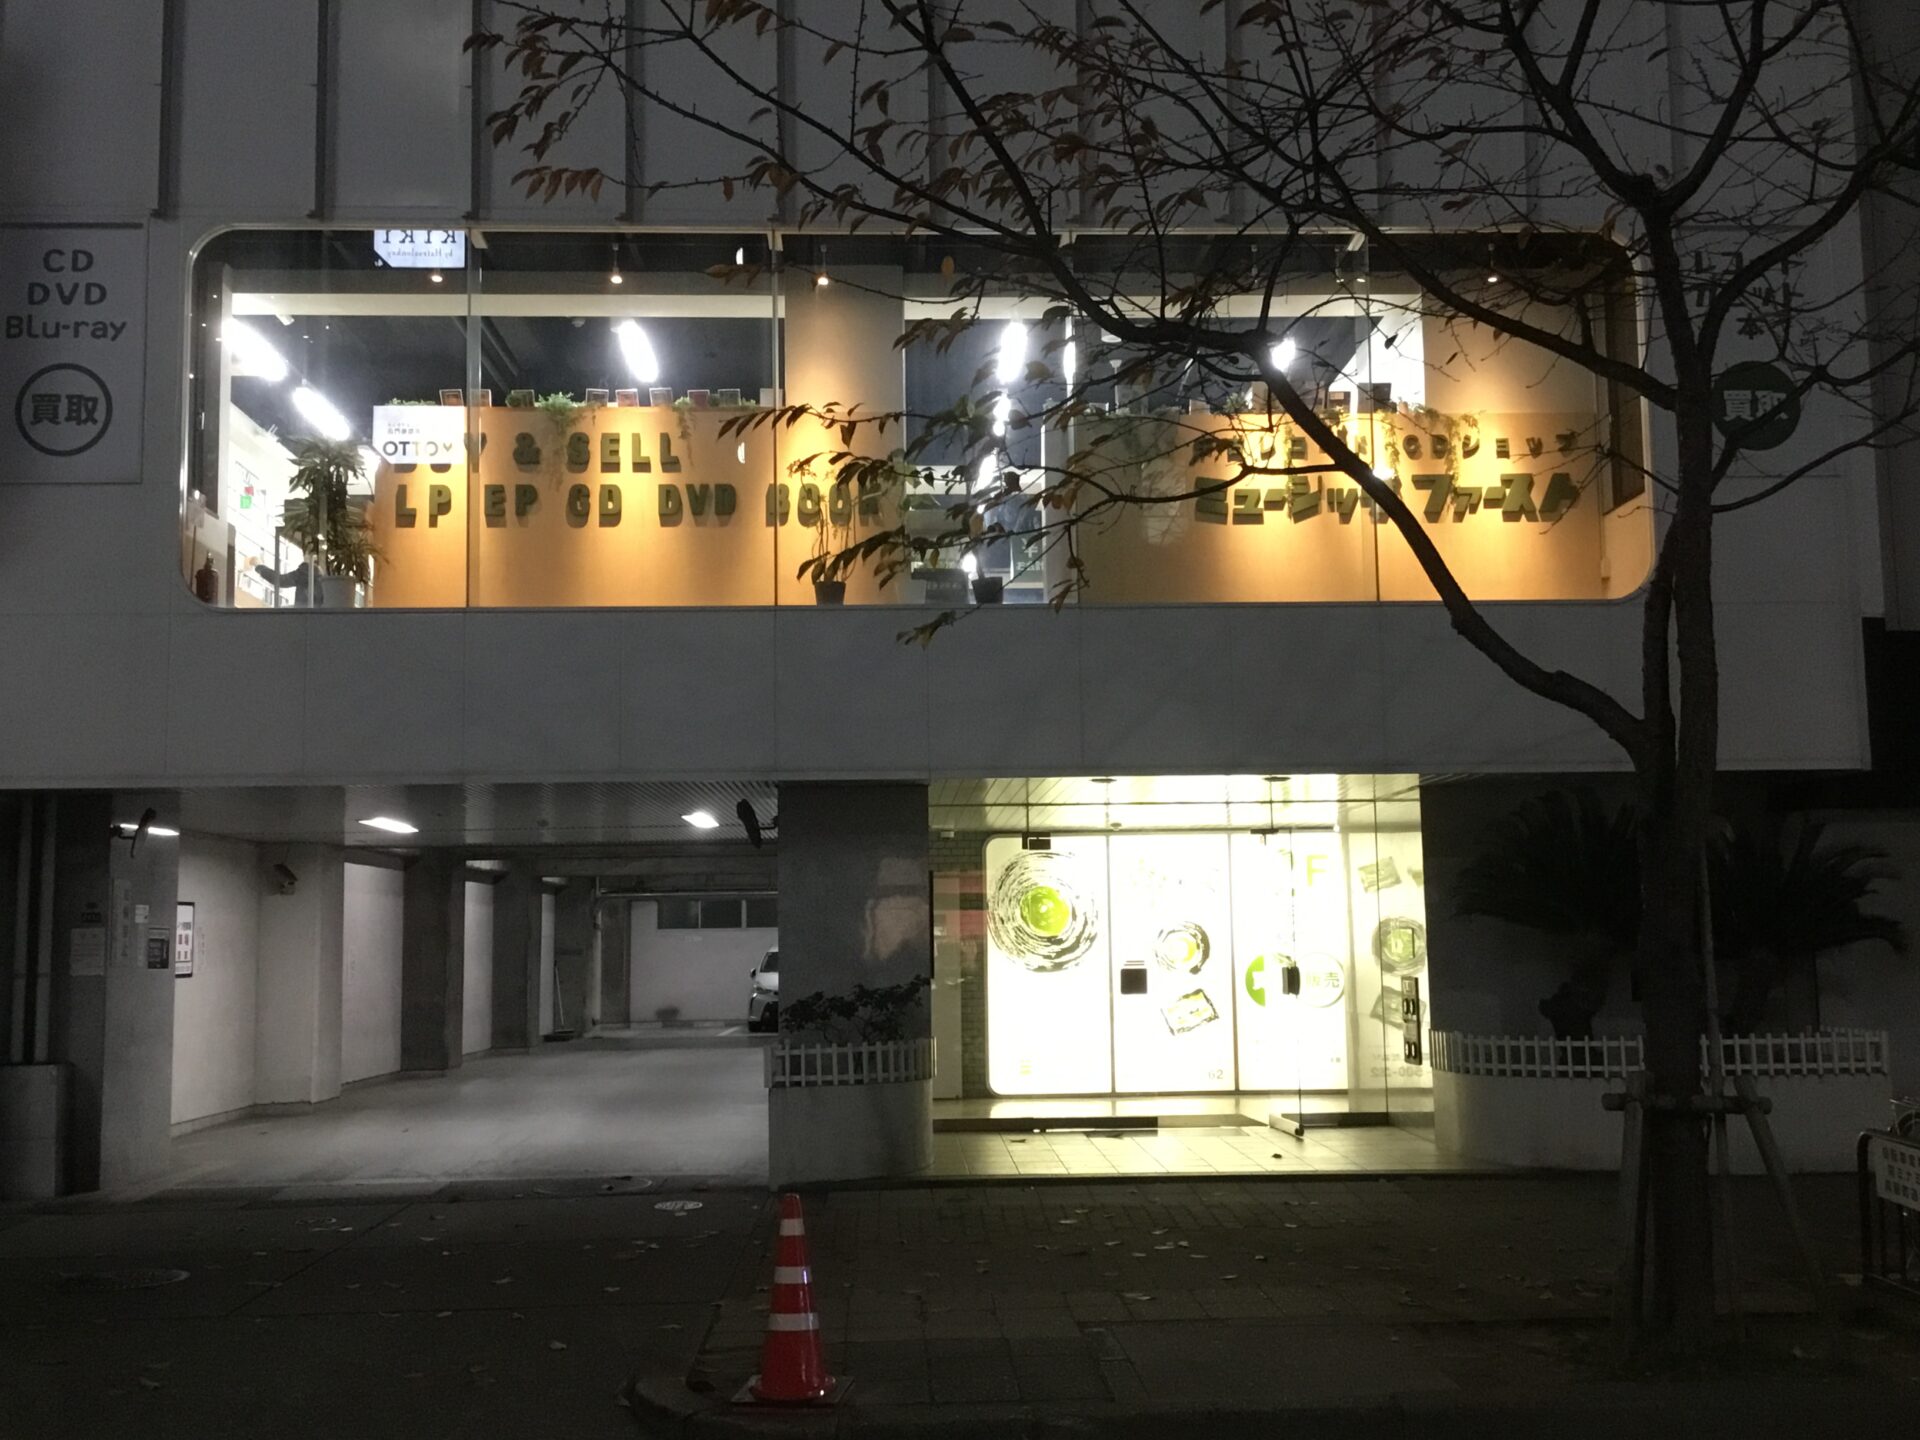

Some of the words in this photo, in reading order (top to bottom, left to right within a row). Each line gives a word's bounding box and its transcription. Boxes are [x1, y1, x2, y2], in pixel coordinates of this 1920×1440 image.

[42, 248, 94, 273] CD
[27, 282, 107, 306] DVD
[29, 393, 99, 426] 買取
[566, 432, 681, 470] SELL
[395, 484, 452, 524] LP
[484, 484, 539, 522] EP
[658, 484, 738, 522] DVD
